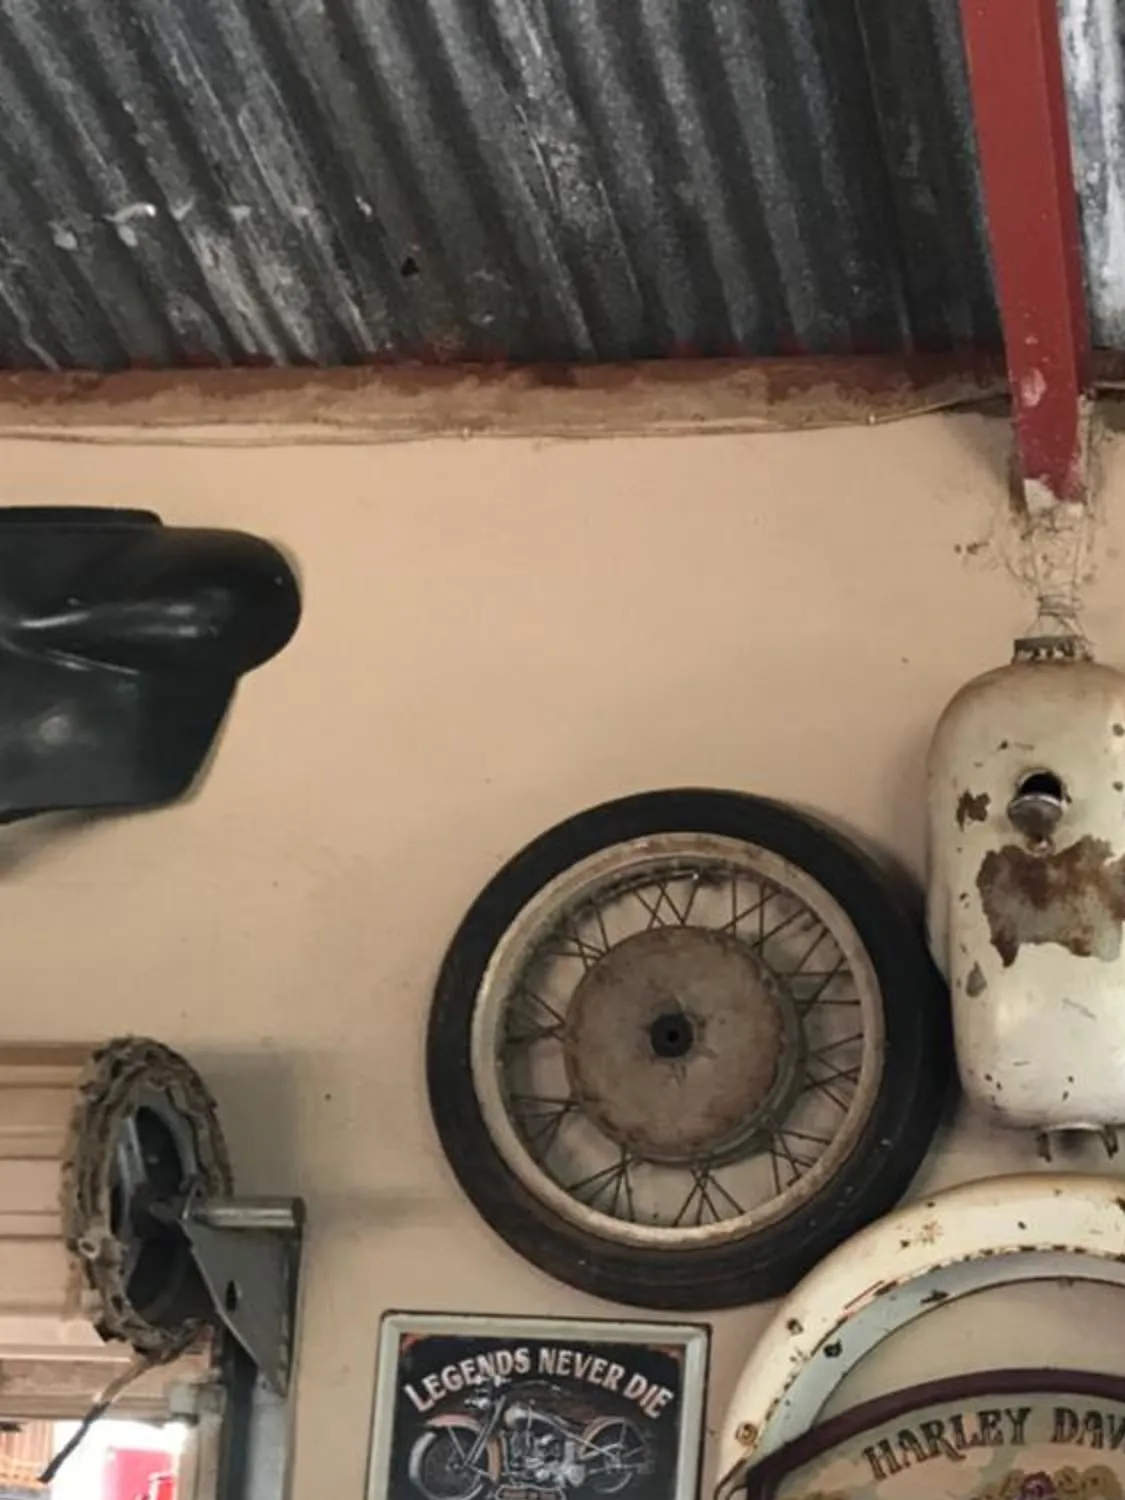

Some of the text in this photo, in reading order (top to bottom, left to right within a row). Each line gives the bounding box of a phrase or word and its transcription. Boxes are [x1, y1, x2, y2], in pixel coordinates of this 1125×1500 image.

[404, 1347, 675, 1419] LEGENDS NEVER DIE
[863, 1407, 1032, 1480] HARLEY
